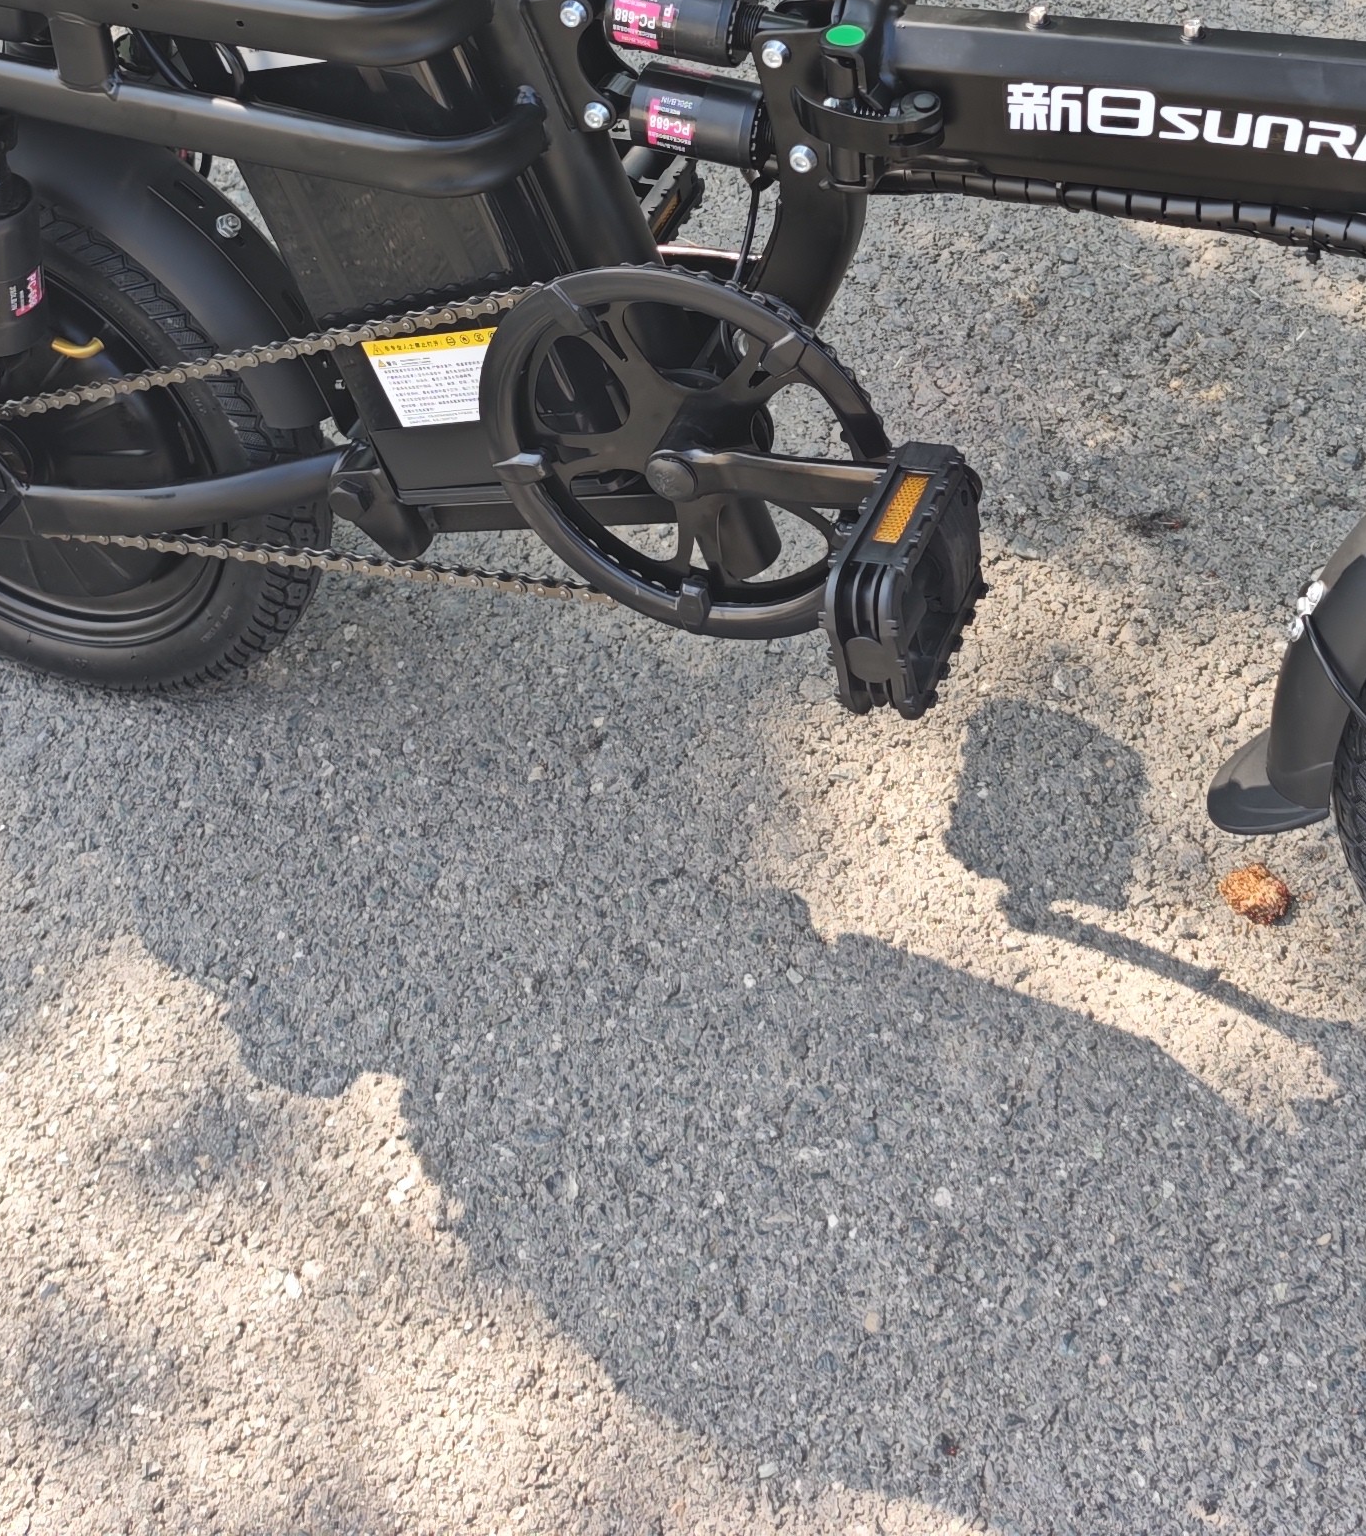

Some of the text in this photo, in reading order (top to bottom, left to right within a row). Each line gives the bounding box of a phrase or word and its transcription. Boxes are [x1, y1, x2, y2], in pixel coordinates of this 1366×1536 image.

[614, 7, 656, 30] PC-688
[1007, 82, 1156, 137] 新日
[649, 115, 691, 136] PC-688
